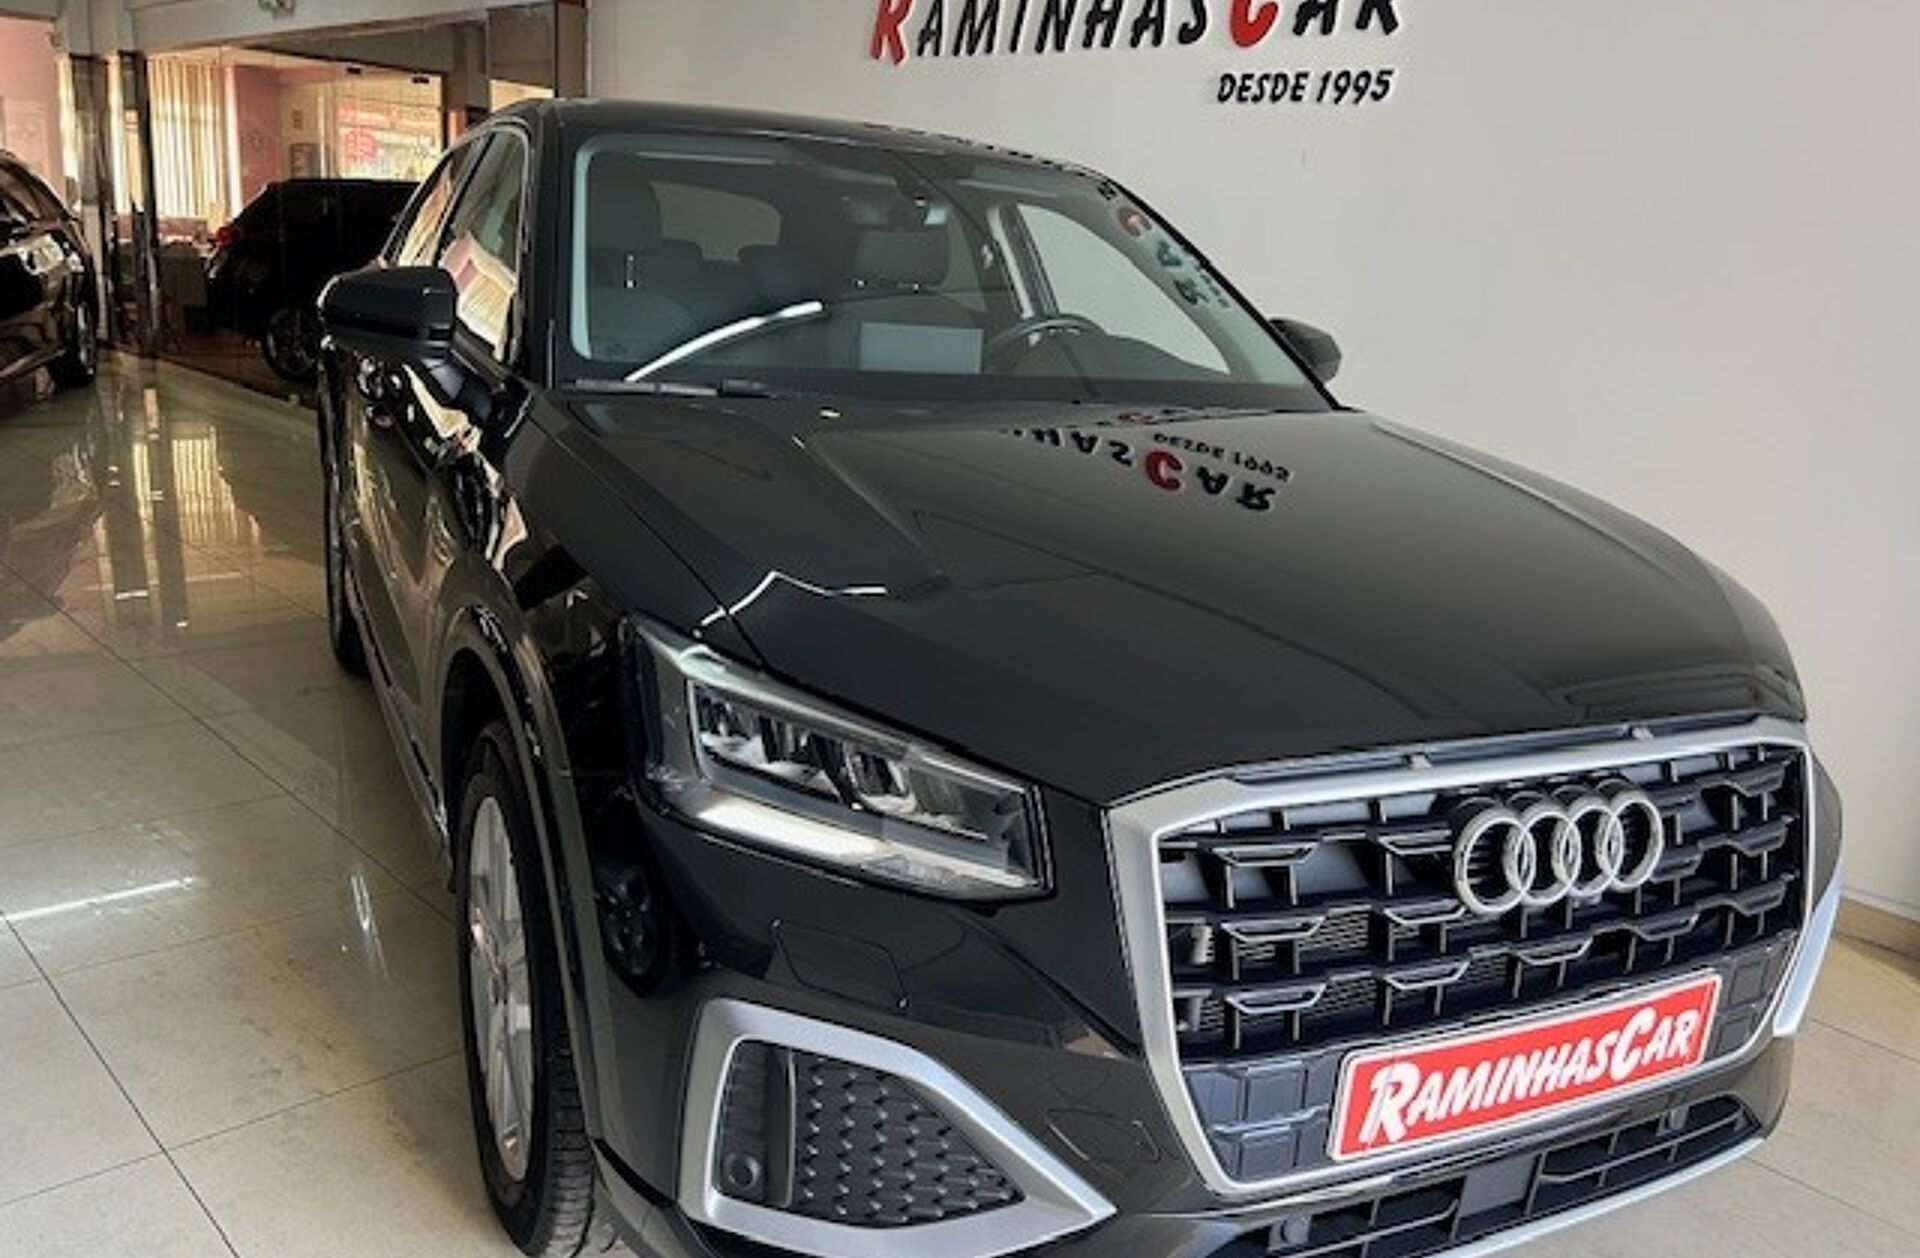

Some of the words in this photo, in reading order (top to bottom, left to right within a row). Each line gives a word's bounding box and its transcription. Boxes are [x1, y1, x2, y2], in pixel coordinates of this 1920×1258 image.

[1217, 72, 1309, 103] DESDE
[1315, 69, 1394, 104] 1995
[1358, 1007, 1702, 1144] RAMINHASCAR
